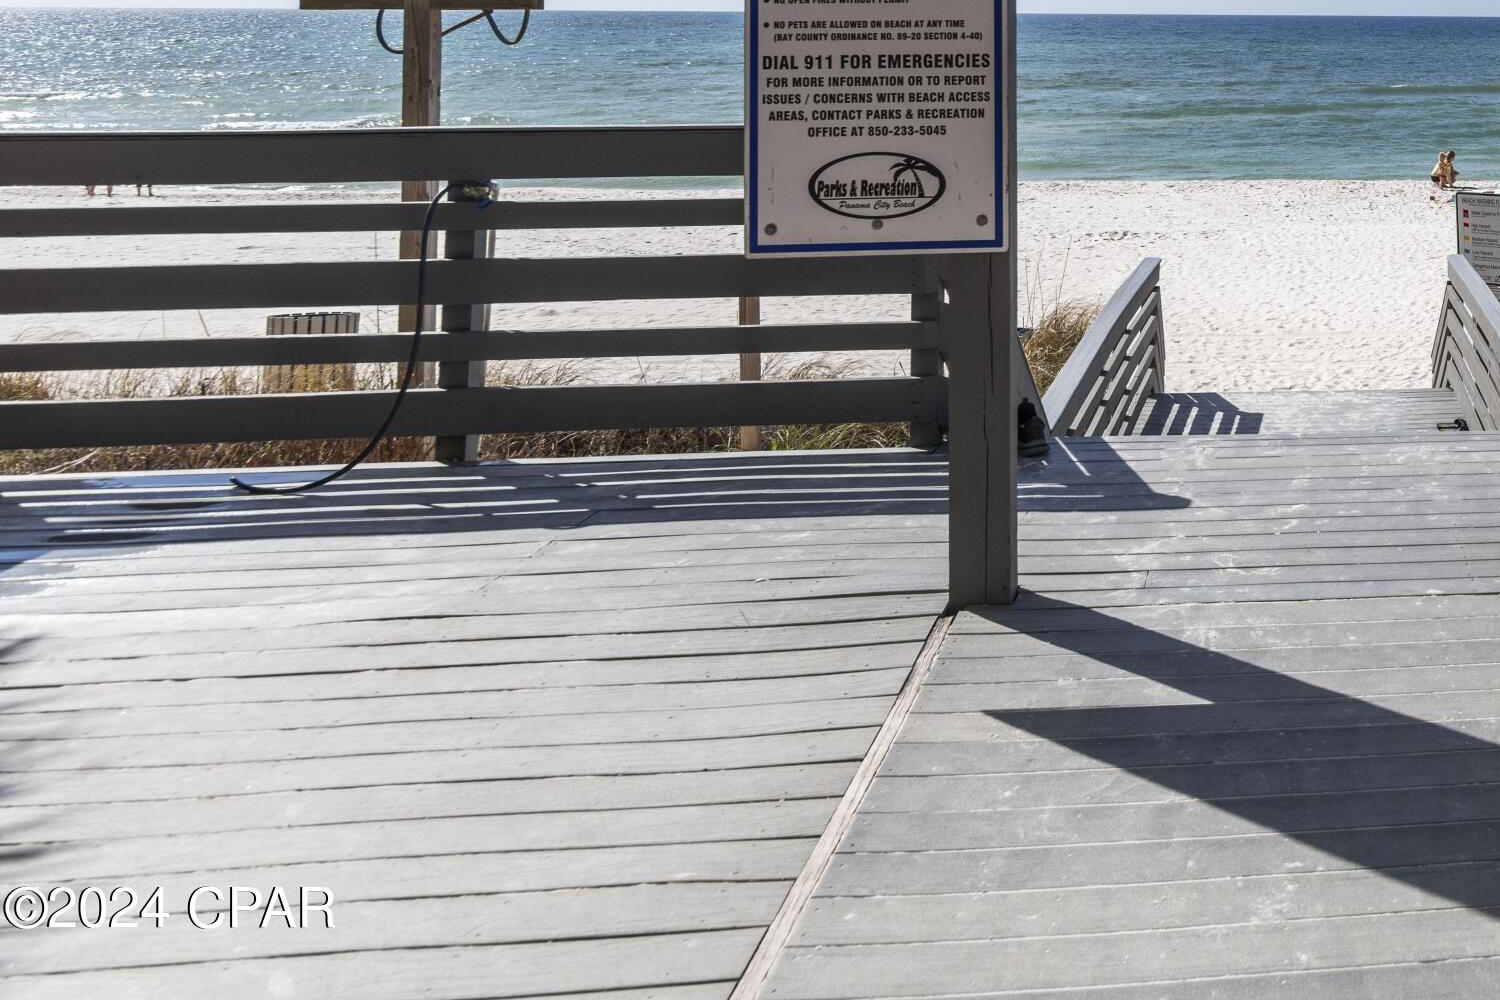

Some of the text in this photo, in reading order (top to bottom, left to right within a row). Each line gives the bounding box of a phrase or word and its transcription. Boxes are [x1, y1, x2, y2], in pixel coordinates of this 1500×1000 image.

[762, 54, 990, 70] DIAL 911 FOR EMERGENCIES
[807, 126, 946, 137] OFFICE AT 850-233-5045
[817, 179, 919, 197] Parks & Recreation
[838, 200, 918, 210] Panama City Beach
